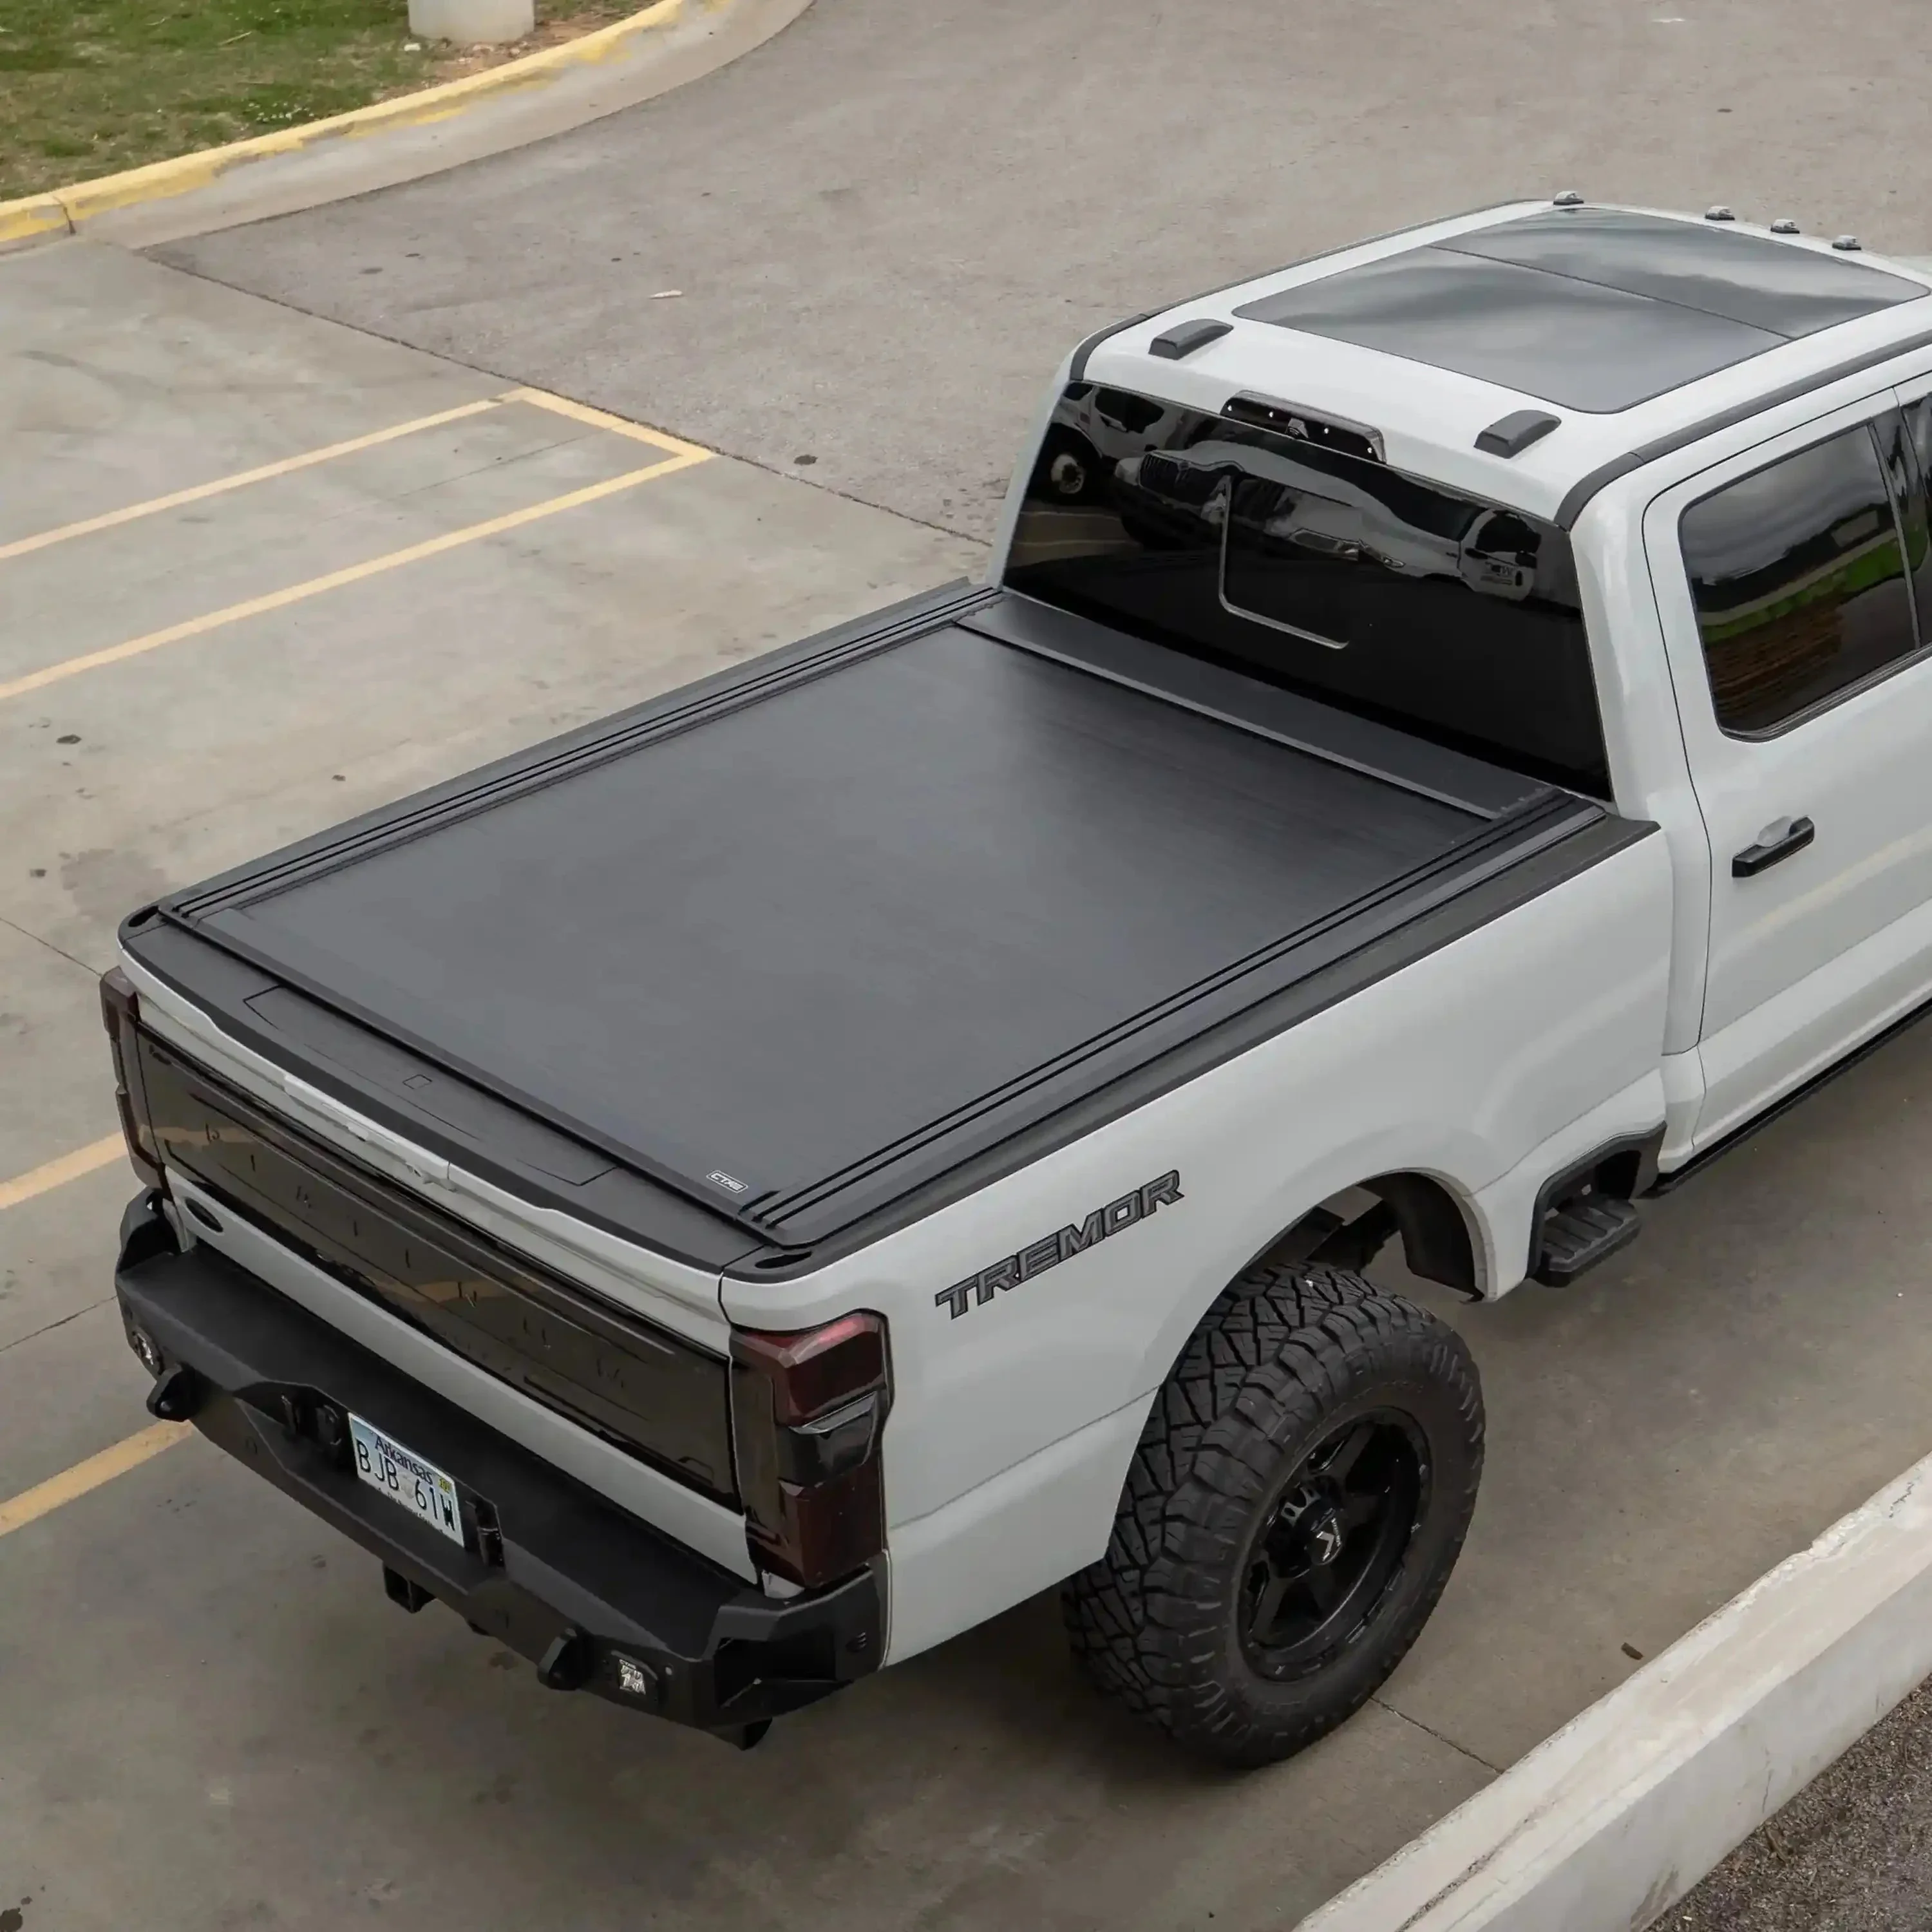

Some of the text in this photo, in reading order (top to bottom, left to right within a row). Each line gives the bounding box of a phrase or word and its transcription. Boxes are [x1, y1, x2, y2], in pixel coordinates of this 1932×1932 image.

[934, 1169, 1185, 1320] TREMOR
[356, 1438, 399, 1491] BJB
[415, 1479, 455, 1531] 61W
[375, 1435, 433, 1485] Arkansas
